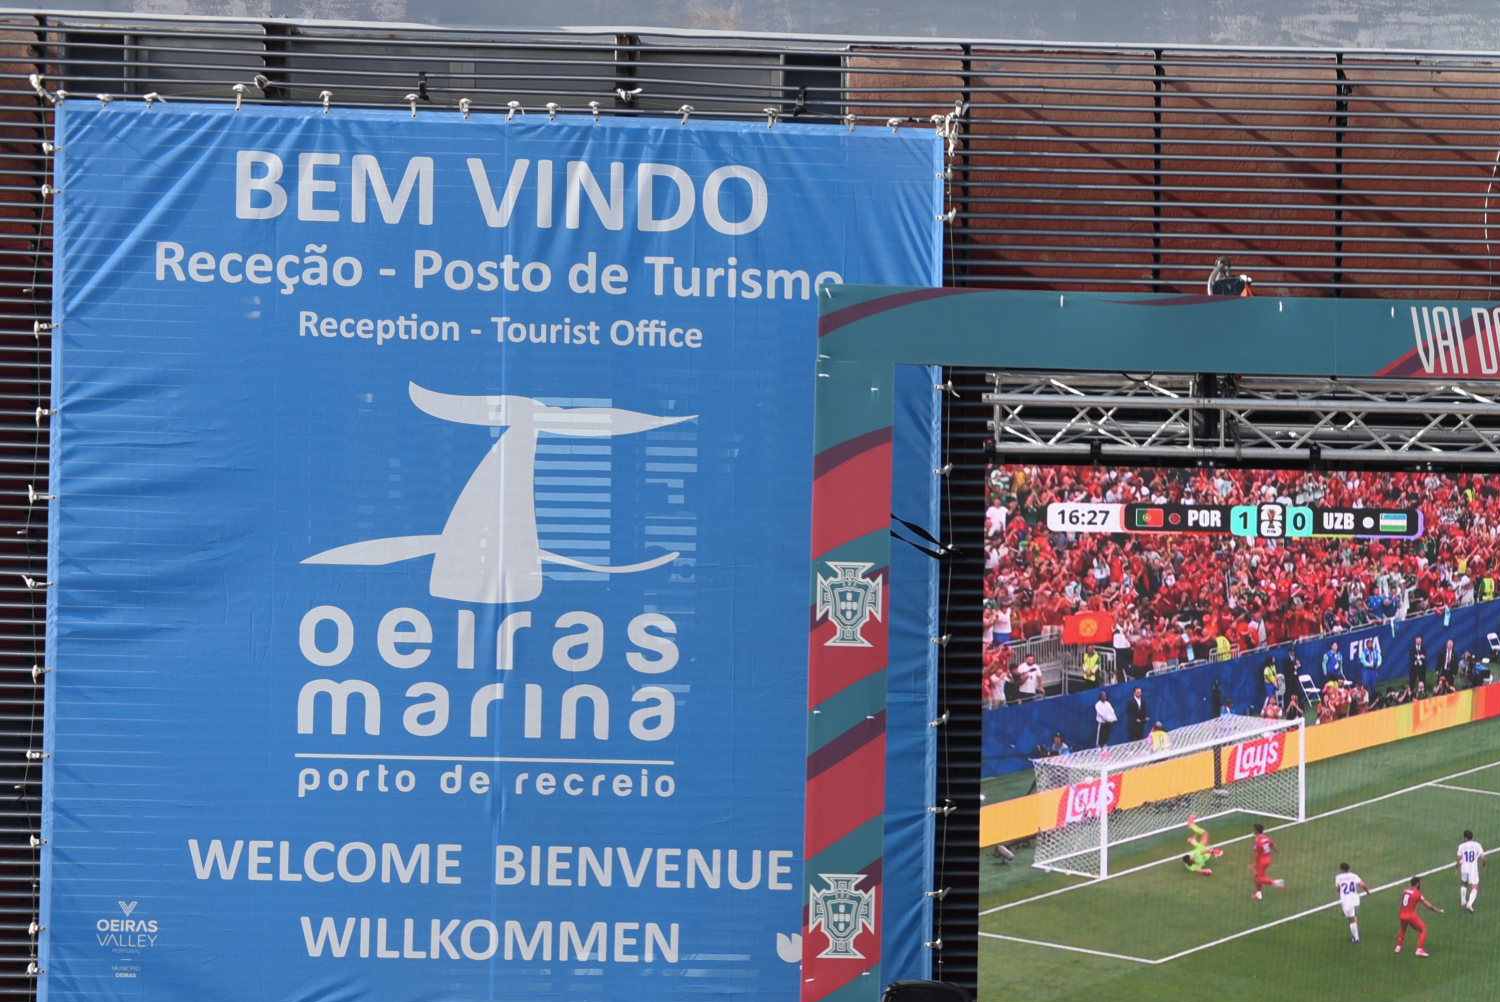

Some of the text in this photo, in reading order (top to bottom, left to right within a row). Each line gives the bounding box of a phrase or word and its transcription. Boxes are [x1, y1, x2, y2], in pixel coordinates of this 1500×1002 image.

[235, 150, 768, 236] BEM VINDO
[155, 241, 363, 295] Receção
[414, 249, 552, 293] Posto
[568, 251, 629, 295] de
[299, 310, 460, 346] Reception
[490, 316, 600, 345] Tourist
[610, 319, 703, 348] Office
[1410, 306, 1468, 374] VAI
[1057, 509, 1355, 531] 16:27 POR 1 0 UZB
[298, 605, 680, 674] oeiras
[297, 678, 676, 741] marina
[297, 764, 675, 798] porto de recreio
[187, 838, 793, 891] WELCOME BIENVENUE
[1340, 881, 1356, 895] 24
[96, 918, 158, 933] OEIRAS
[96, 933, 158, 948] VALLEY
[300, 916, 679, 963] WILLKOMMEN
